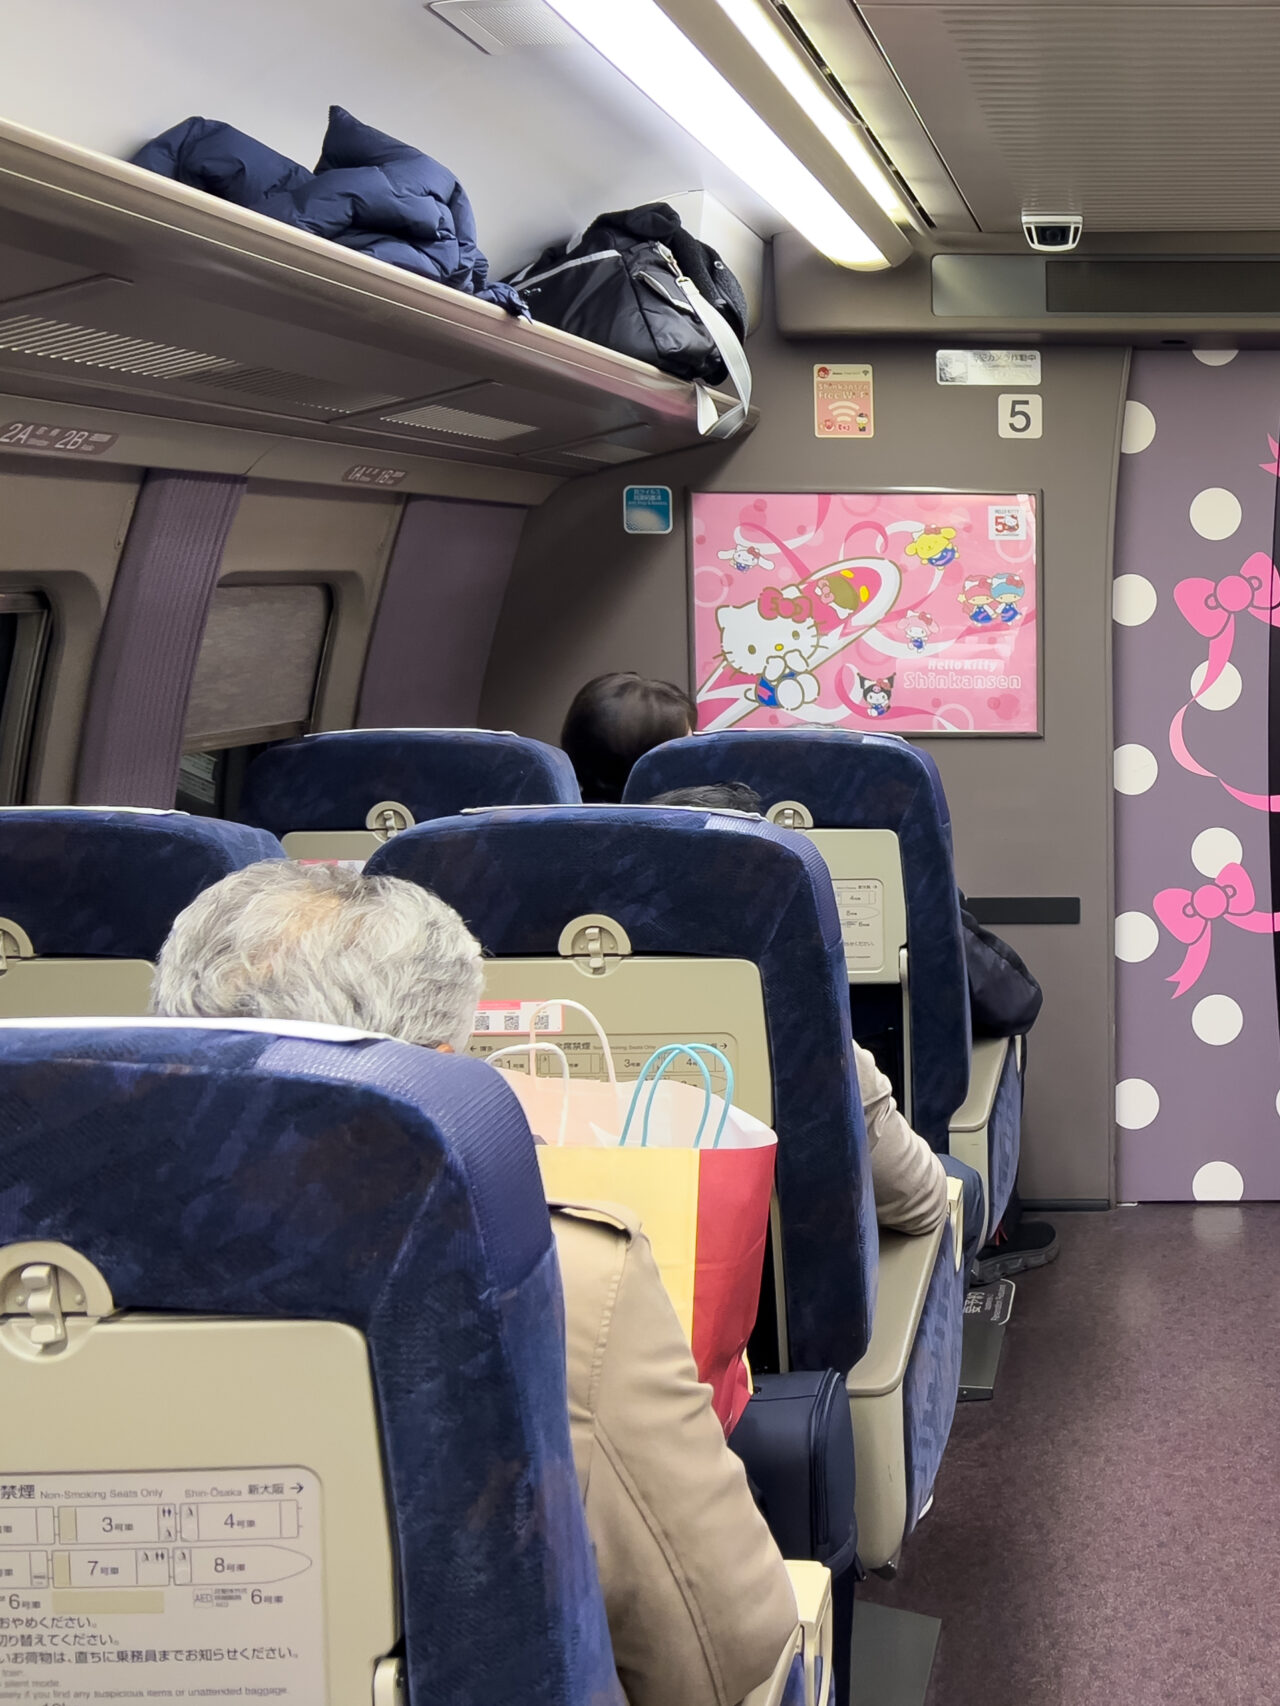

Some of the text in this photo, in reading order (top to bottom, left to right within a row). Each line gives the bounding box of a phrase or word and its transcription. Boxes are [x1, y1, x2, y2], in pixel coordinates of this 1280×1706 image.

[1008, 400, 1031, 433] 5
[0, 422, 34, 445] 2A
[54, 430, 89, 450] 2B
[903, 672, 1021, 689] Shinkansen
[40, 1488, 163, 1500] Non-Smoking Seats Only
[248, 1484, 284, 1495] 新大阪
